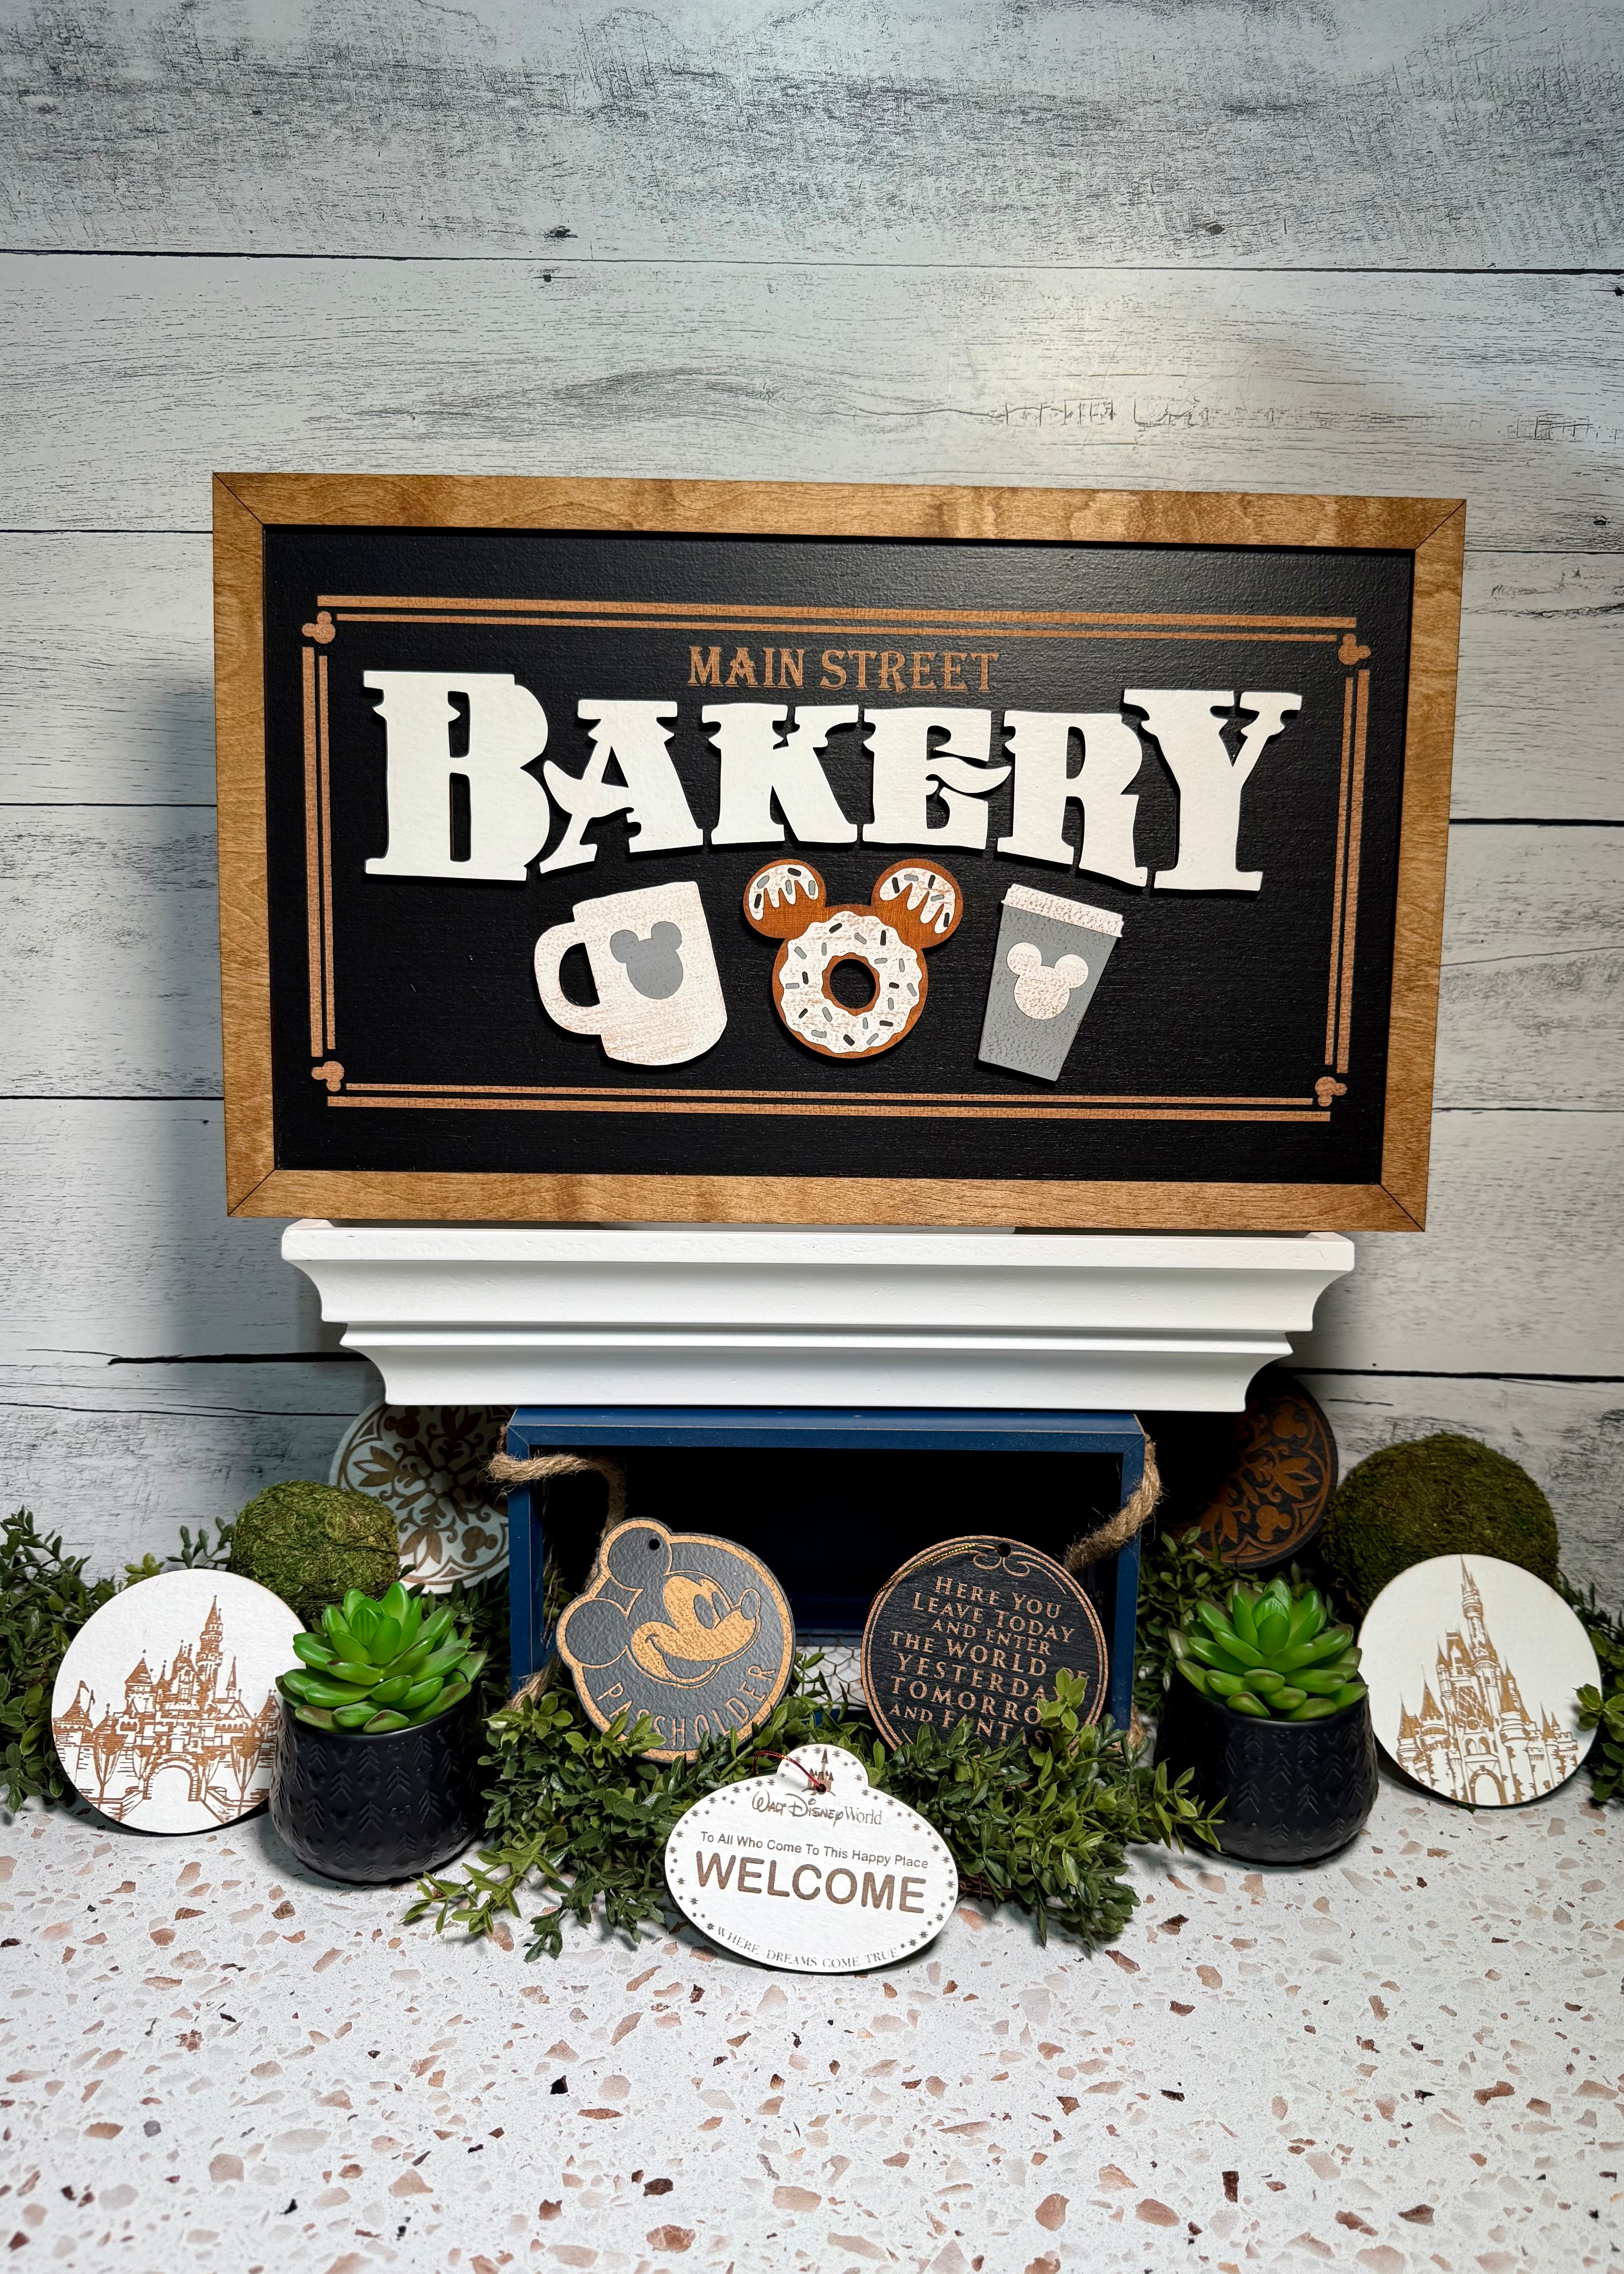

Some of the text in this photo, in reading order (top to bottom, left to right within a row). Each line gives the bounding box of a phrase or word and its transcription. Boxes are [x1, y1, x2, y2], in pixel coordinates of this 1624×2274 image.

[688, 646, 999, 694] MAIN STREET
[362, 670, 1302, 893] BAKERY
[913, 1592, 1075, 1643] LEAVE TODAY
[935, 1576, 1061, 1618] HERE YOU
[890, 1630, 934, 1653] THE
[946, 1639, 1047, 1677] WORLD
[931, 1618, 1051, 1656] AND ENTER
[889, 1703, 933, 1722] AND
[891, 1675, 1042, 1725] TOMORRO
[844, 1806, 883, 1825] World
[701, 1832, 929, 1869] To All Who Come To This Happy Place
[696, 1850, 927, 1914] WELCOME
[718, 1926, 899, 1969] WHERE DREAMS COME TRUE
